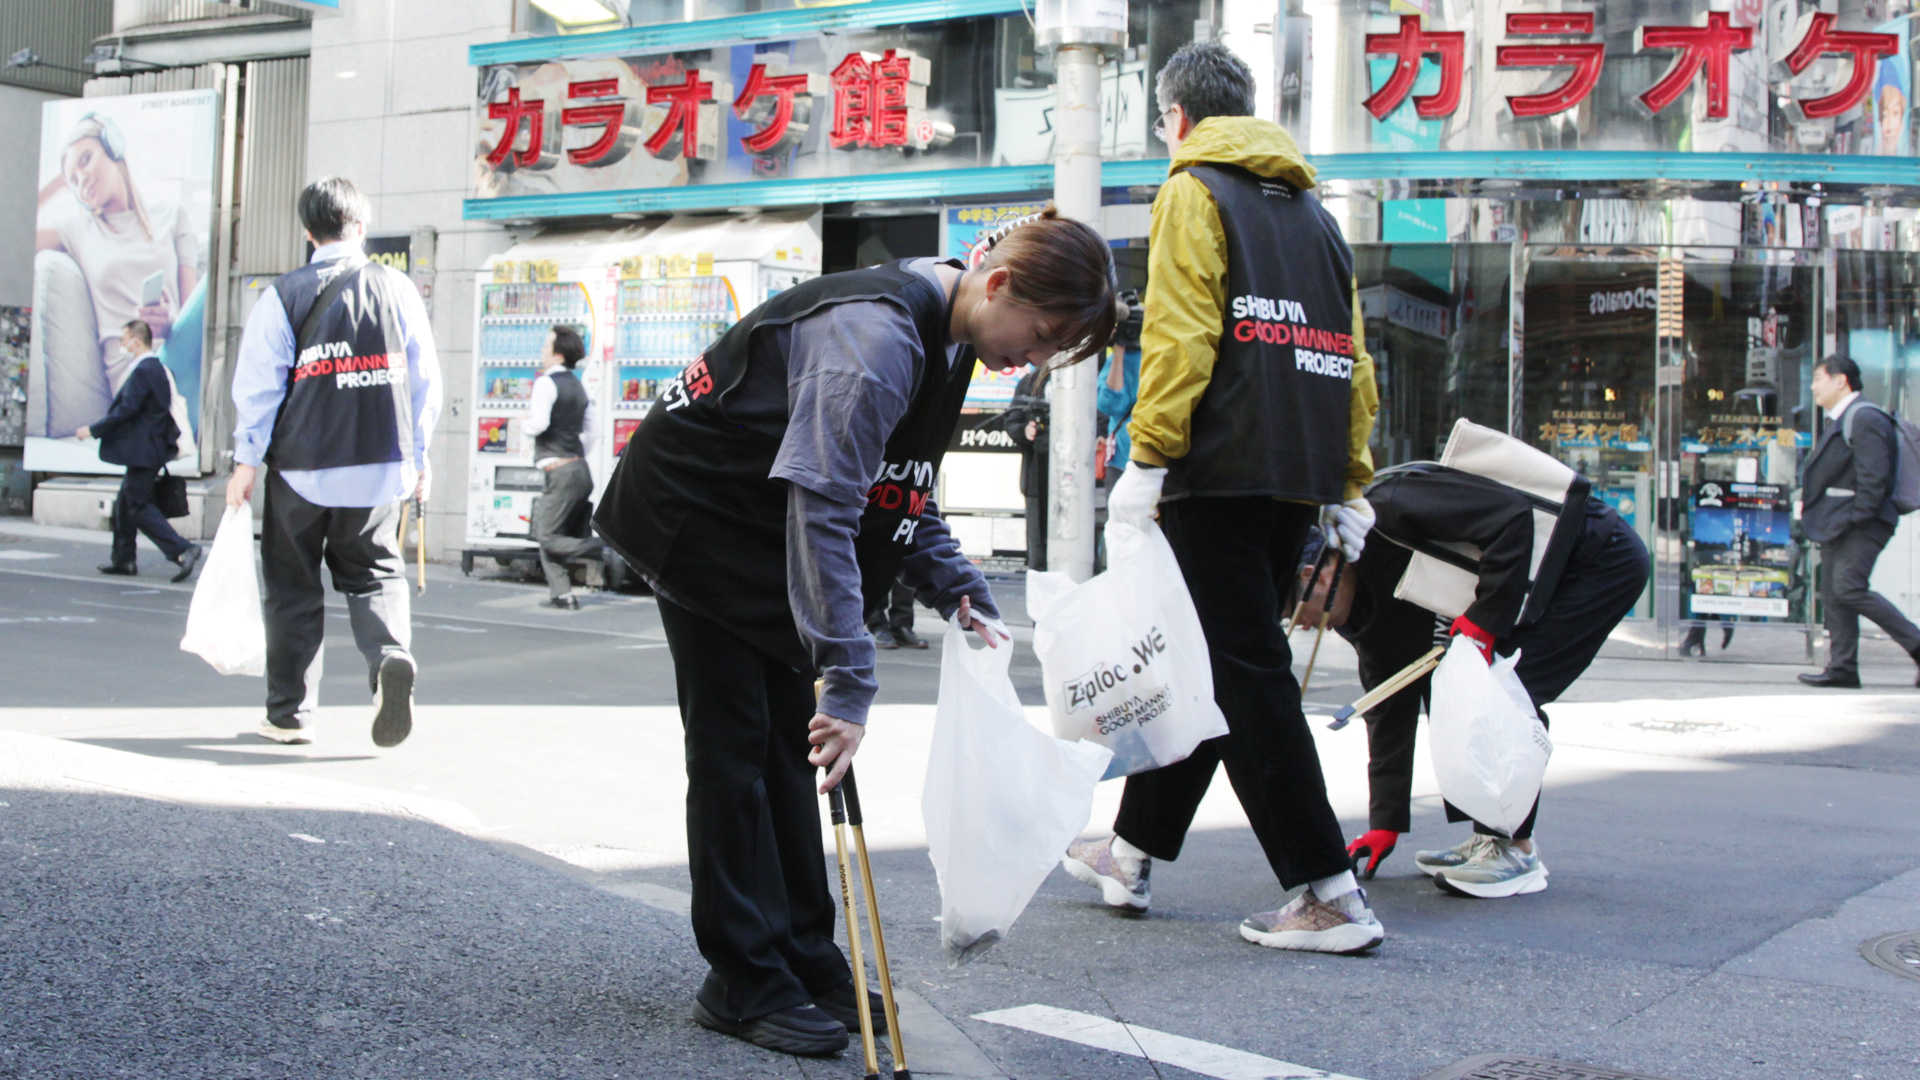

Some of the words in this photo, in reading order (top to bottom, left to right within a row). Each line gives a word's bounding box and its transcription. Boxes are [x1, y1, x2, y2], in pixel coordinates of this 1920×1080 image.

[1363, 11, 1899, 120] カラオケ
[487, 49, 911, 171] カラオケ館
[1234, 320, 1291, 345] GOOD
[296, 341, 353, 369] HIBUYA
[1294, 348, 1353, 380] PROJECT
[336, 368, 405, 389] PROJECT
[1068, 664, 1128, 707] Ziploc
[1096, 695, 1143, 726] SHIBUYA
[1100, 713, 1134, 736] GOOD
[839, 863, 848, 894] LEAGUE
